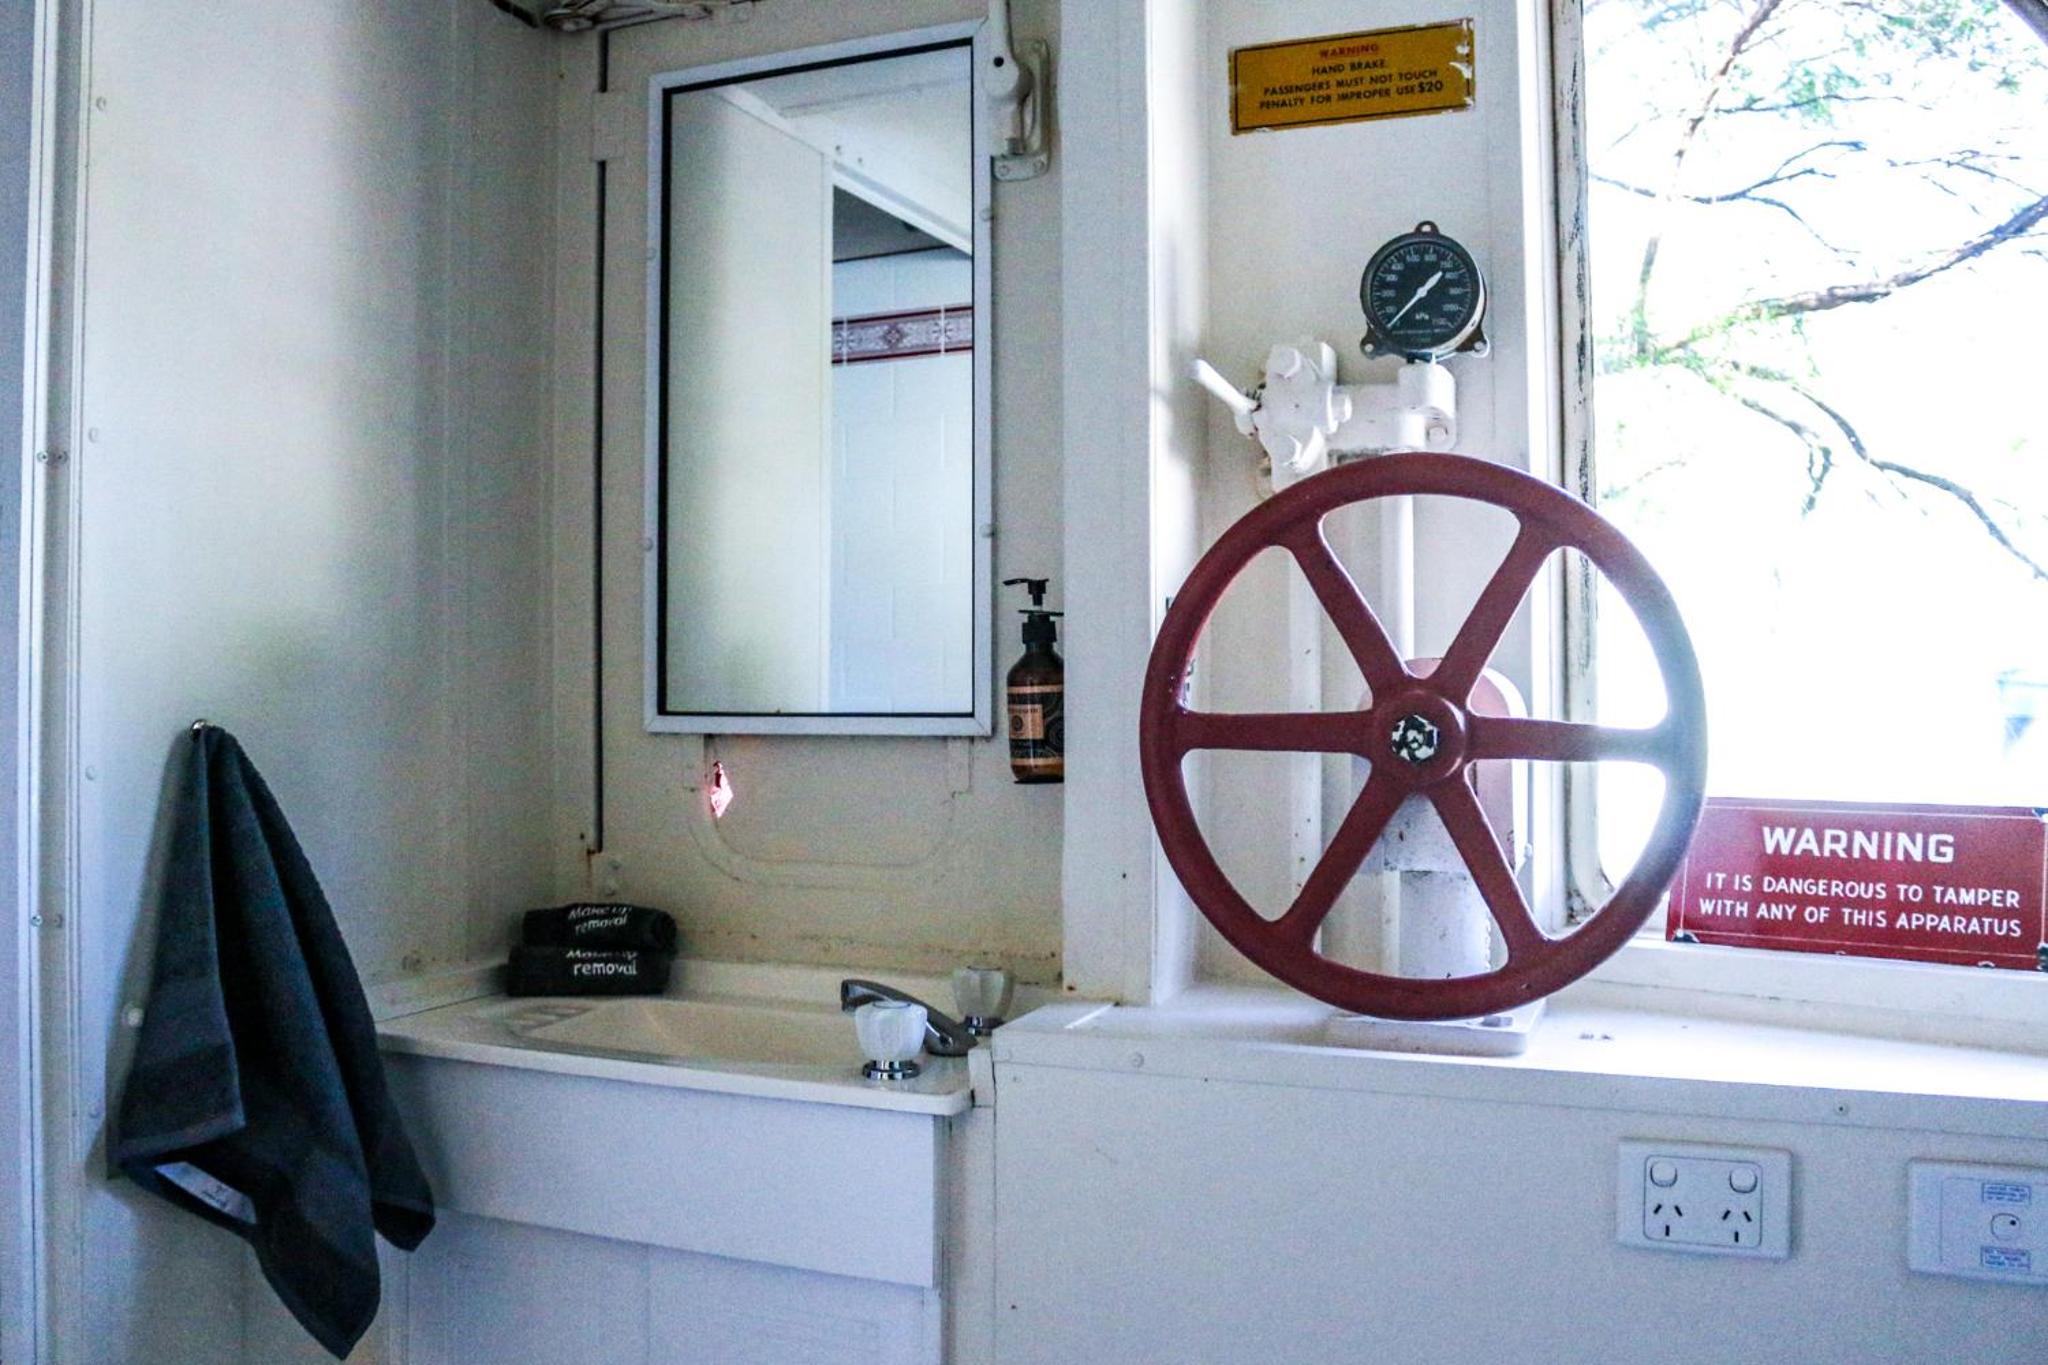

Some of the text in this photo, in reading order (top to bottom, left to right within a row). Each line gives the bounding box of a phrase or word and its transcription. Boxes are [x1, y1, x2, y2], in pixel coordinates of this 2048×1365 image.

[1319, 43, 1379, 59] WARNING
[1312, 59, 1386, 76] HAND BRAKE
[1259, 80, 1443, 110] PENALTY FOR IMPROPER USE $20
[1263, 69, 1438, 96] PASSENGERS MUST NOT TOUCH
[1762, 825, 1956, 864] WARNING
[1706, 872, 2021, 909] IT IS DANGEROUS TO TAMPER
[1699, 898, 2022, 937] WITH ANY OF THIS APPARATUS
[573, 959, 638, 976] removal
